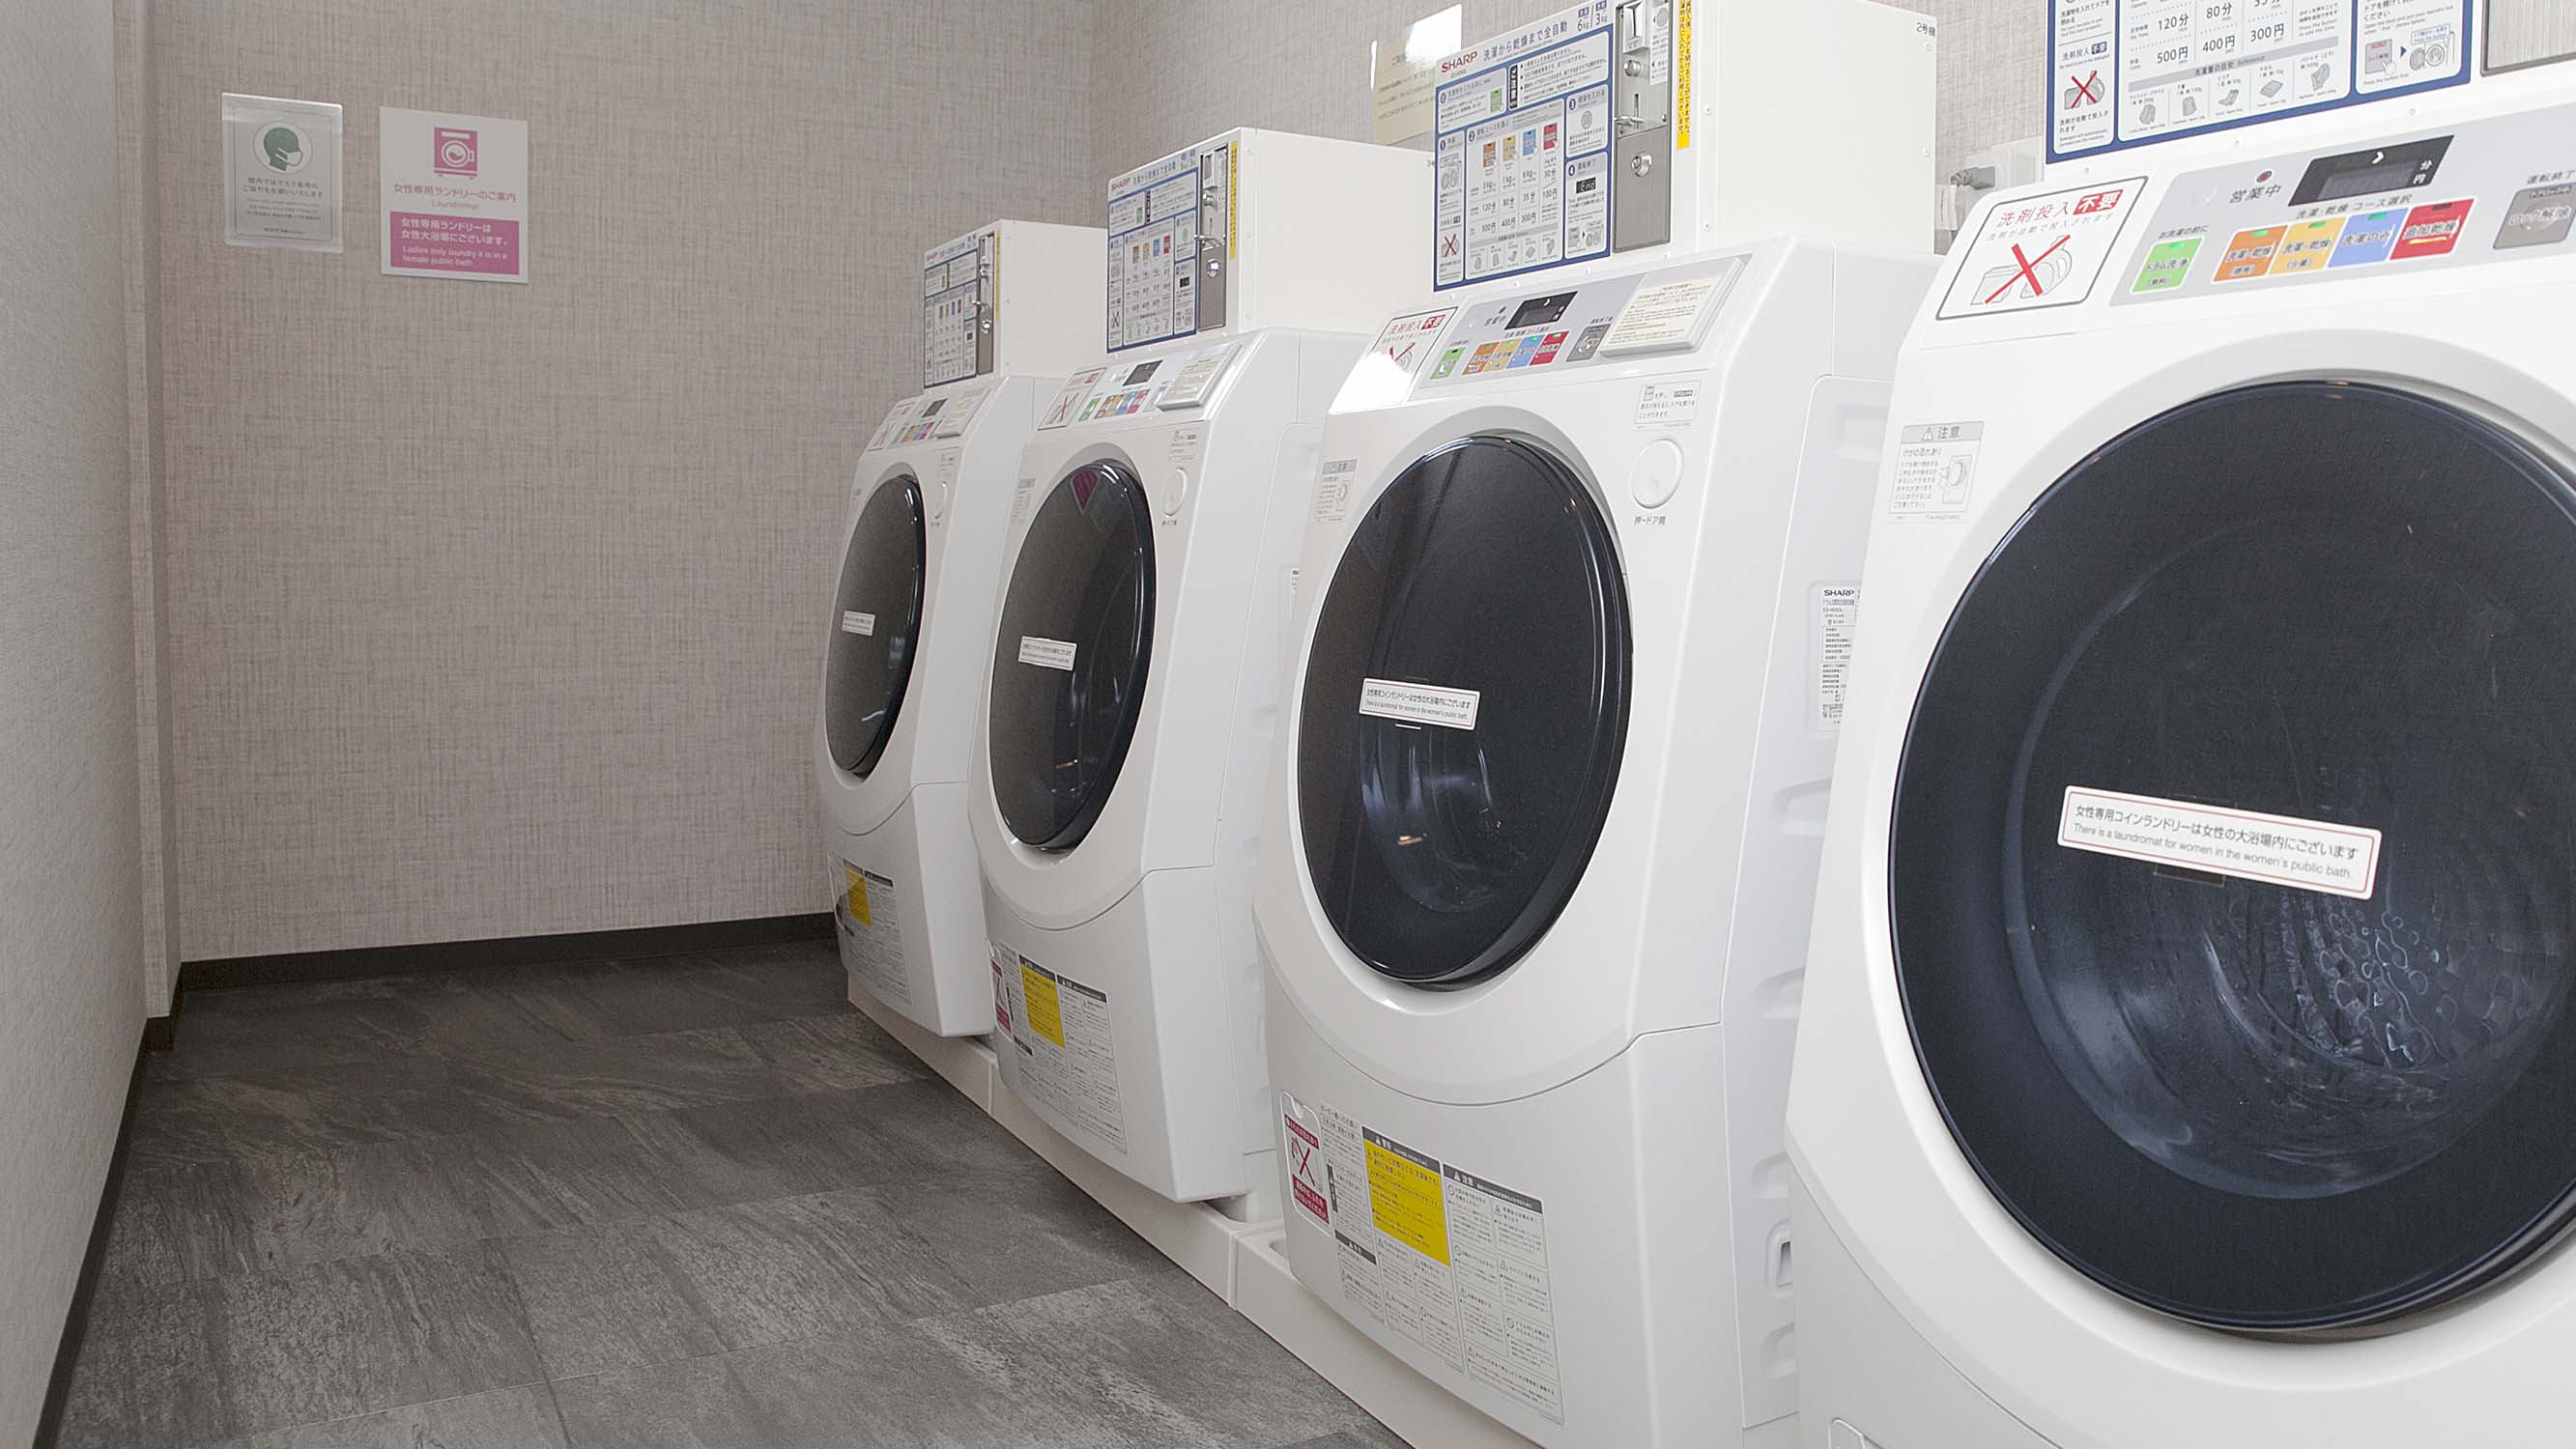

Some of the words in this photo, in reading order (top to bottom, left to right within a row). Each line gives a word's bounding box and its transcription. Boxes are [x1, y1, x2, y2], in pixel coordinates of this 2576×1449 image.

[2206, 2, 2233, 19] 80分
[2363, 9, 2391, 21] ください
[2158, 13, 2190, 31] 120分
[1483, 20, 1568, 62] 洗濯から乾燥まで全自動
[2250, 23, 2285, 43] 300円
[2202, 35, 2235, 53] 400円
[1441, 51, 1478, 73] SHARP
[2061, 48, 2090, 62] 洗剤投入
[2157, 45, 2189, 65] 500円
[2420, 159, 2433, 171] 分
[1580, 179, 1595, 192] End
[2413, 173, 2426, 185] 円
[393, 183, 518, 203] 女性専用ランドリーのご案内
[2228, 184, 2281, 204] 営業中
[1996, 203, 2070, 229] 洗剤投入
[2077, 190, 2121, 213] 不要
[2296, 203, 2349, 219] 洗濯・乾燥
[2353, 193, 2413, 212] コース選択
[401, 217, 492, 233] 女性専用ランドリーは
[1501, 216, 1516, 229] 400円
[1521, 212, 1536, 224] 300円
[1988, 213, 2115, 242] 洗剤が自動で投入されます
[2159, 225, 2209, 240] お洗濯の前に
[2403, 219, 2457, 240] 追加乾燥
[401, 230, 508, 246] 女性大浴場にございます。
[2342, 228, 2392, 246] 洗濯のみ
[402, 244, 429, 255] Ladies
[429, 247, 447, 257] only
[447, 248, 477, 260] laundry
[402, 255, 429, 264] female
[431, 257, 453, 267] public
[2145, 258, 2188, 272] ドラム洗浄
[2075, 804, 2359, 861] 女性専用コインランドリーは女性の大浴場内にございます
[2074, 822, 2097, 836] There
[2097, 827, 2106, 838] is
[2105, 829, 2112, 838] a
[2113, 828, 2163, 847] laundromat
[2164, 837, 2178, 848] for
[2179, 841, 2214, 856] women
[2215, 847, 2224, 857] in
[2225, 848, 2242, 860] the
[2243, 852, 2289, 868] women's
[2290, 860, 2324, 875] public
